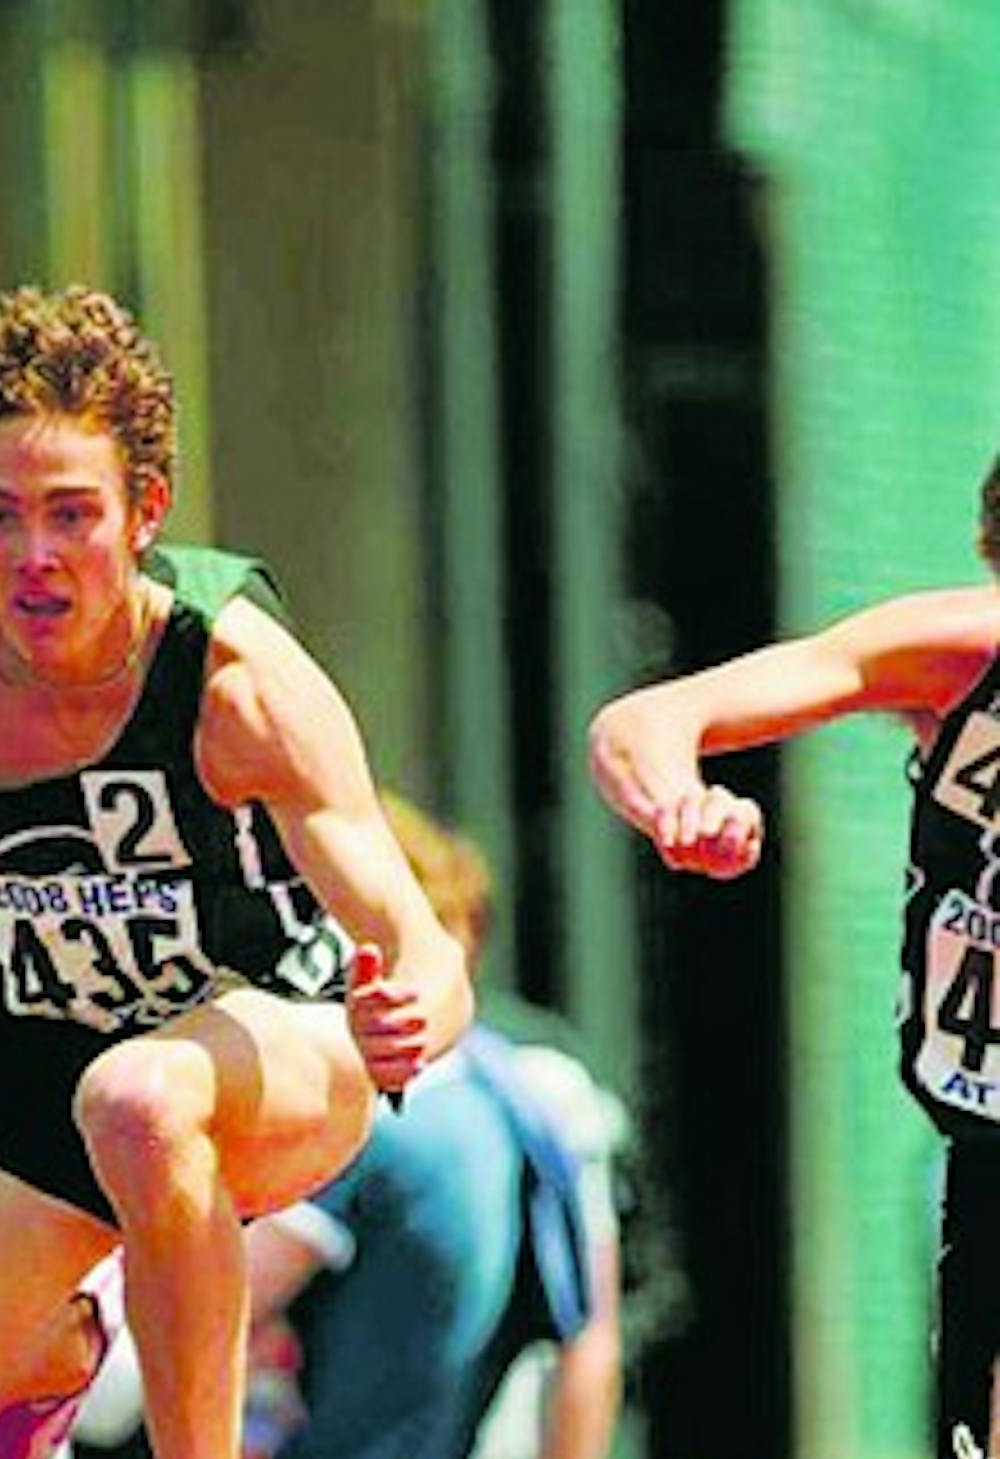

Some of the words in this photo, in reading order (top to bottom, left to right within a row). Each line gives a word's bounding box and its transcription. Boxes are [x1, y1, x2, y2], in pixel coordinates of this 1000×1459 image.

[101, 782, 172, 863] 2
[81, 878, 177, 915] HEPS
[12, 919, 208, 1008] 435
